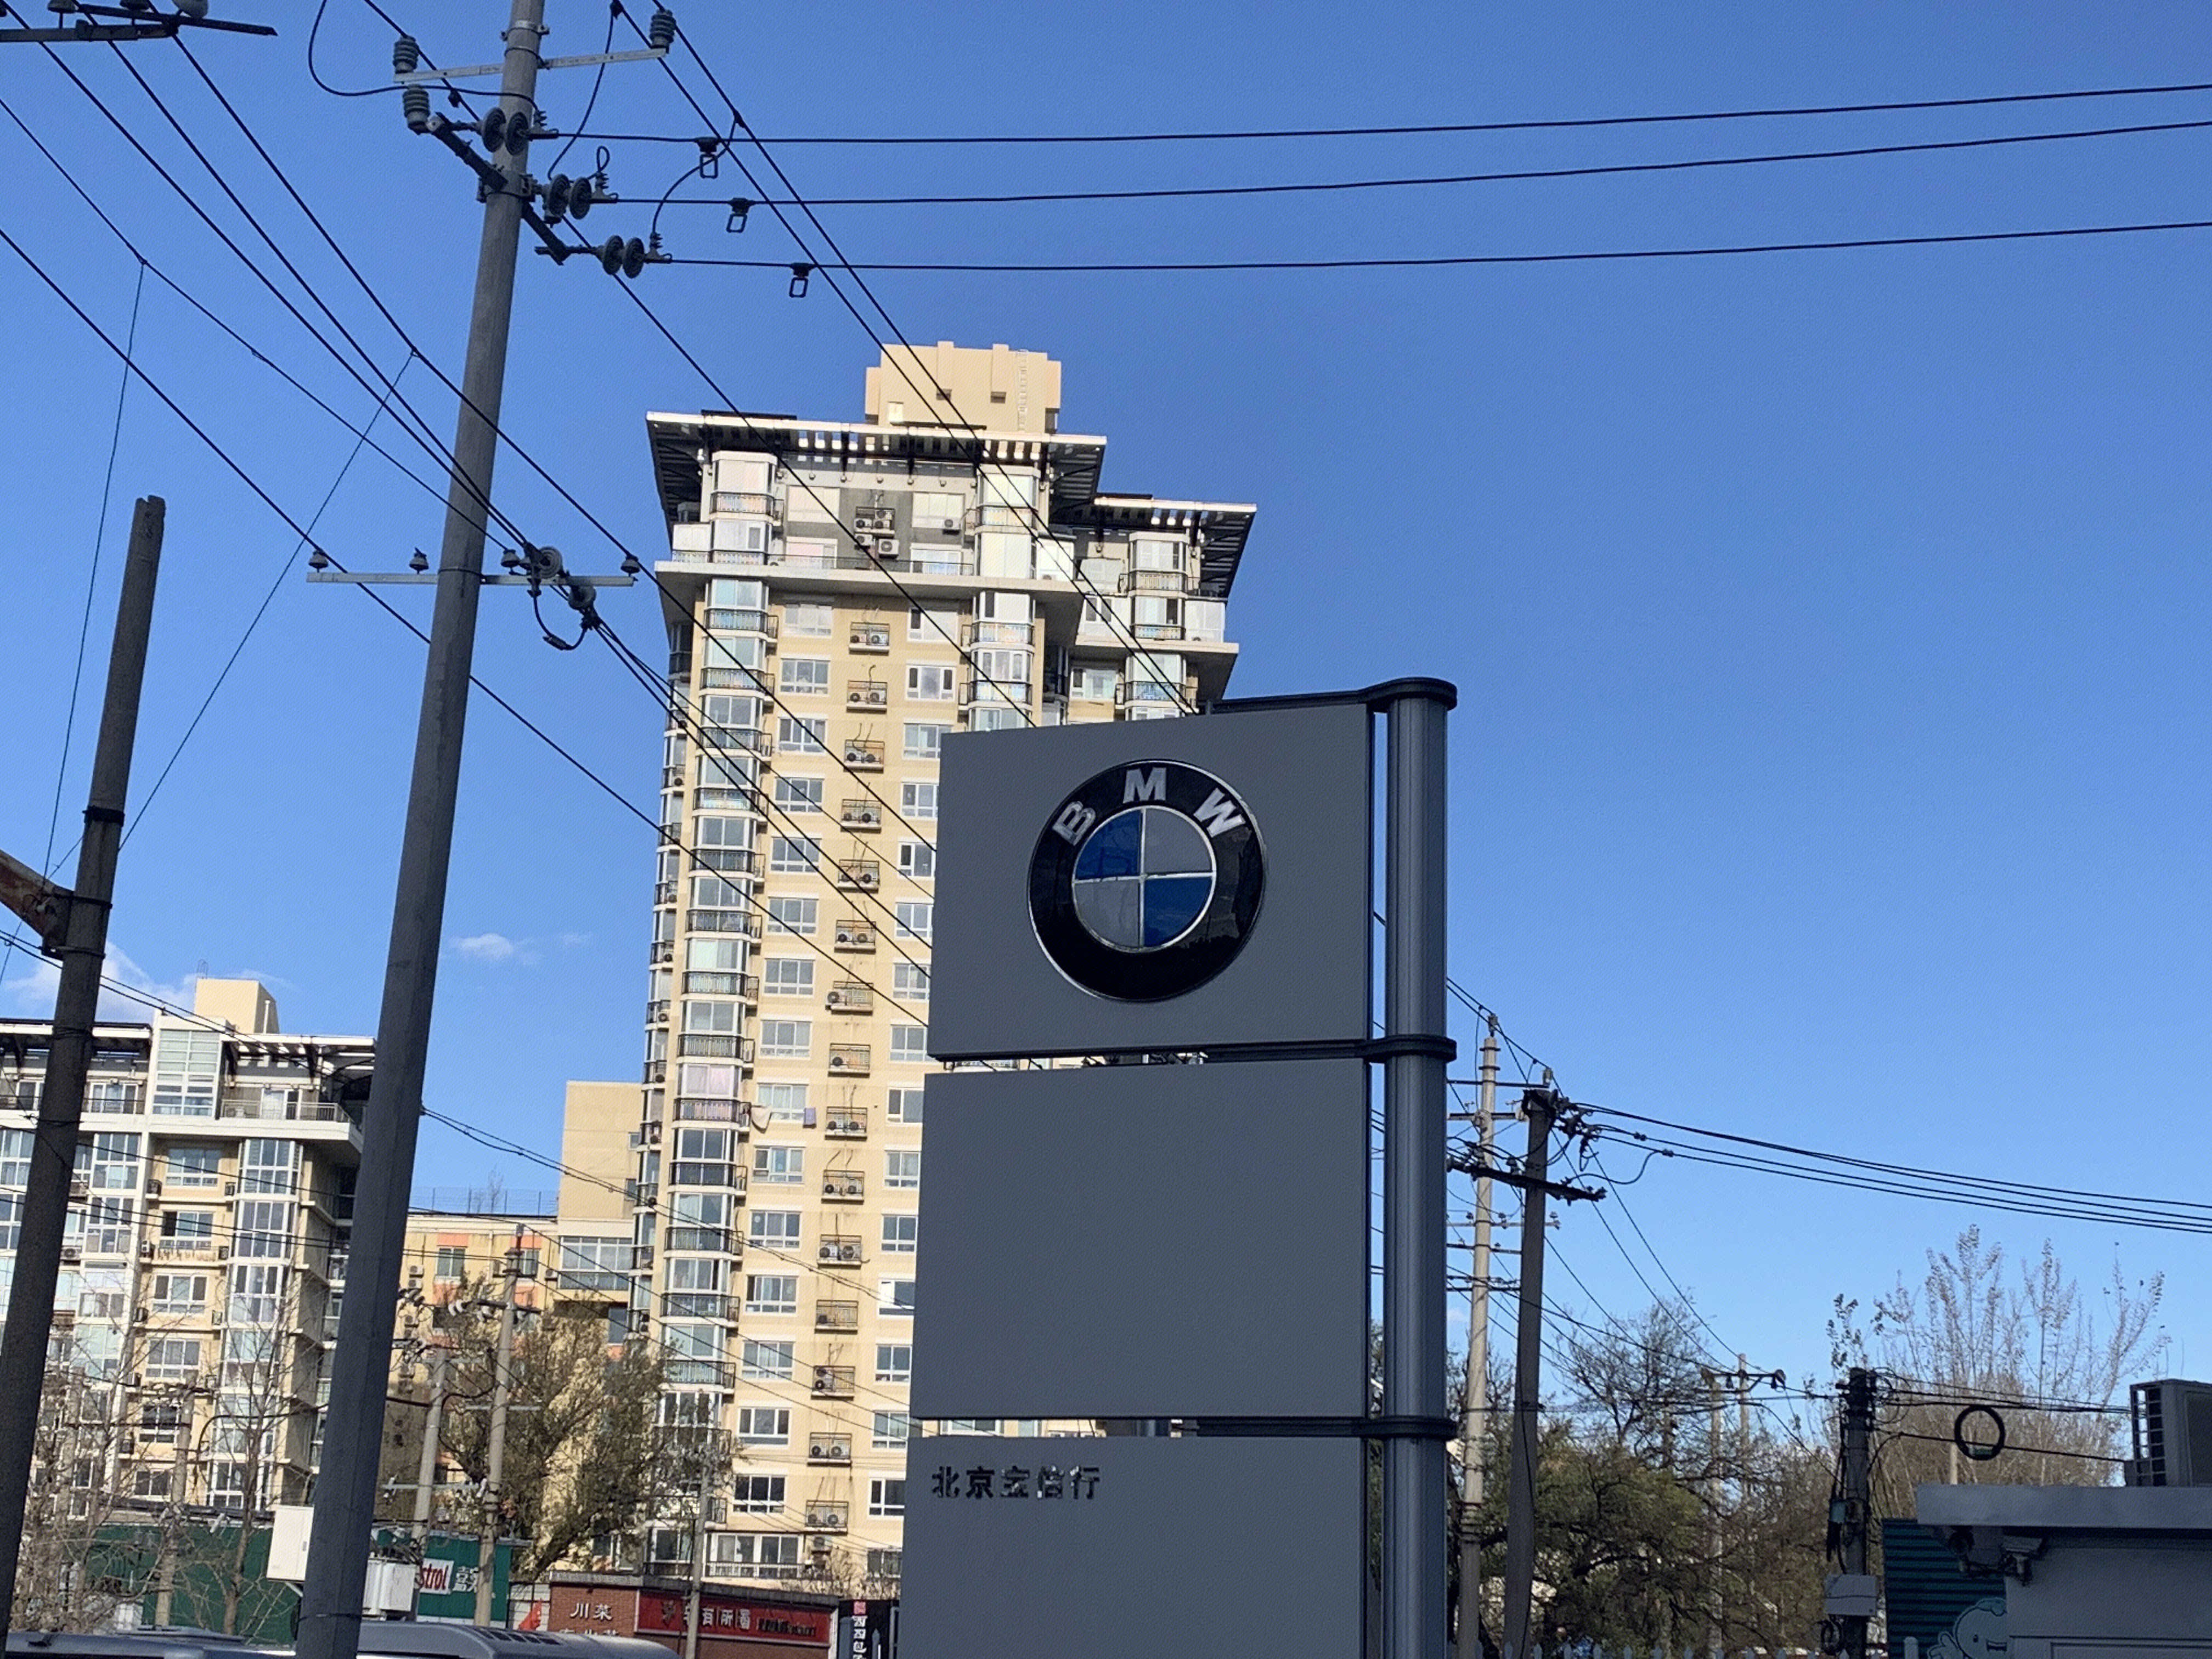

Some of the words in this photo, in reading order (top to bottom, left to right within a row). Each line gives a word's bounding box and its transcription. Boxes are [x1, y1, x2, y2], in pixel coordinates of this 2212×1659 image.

[1052, 766, 1246, 846] BMW
[420, 1563, 449, 1590] strol
[569, 1602, 613, 1621] 川菜
